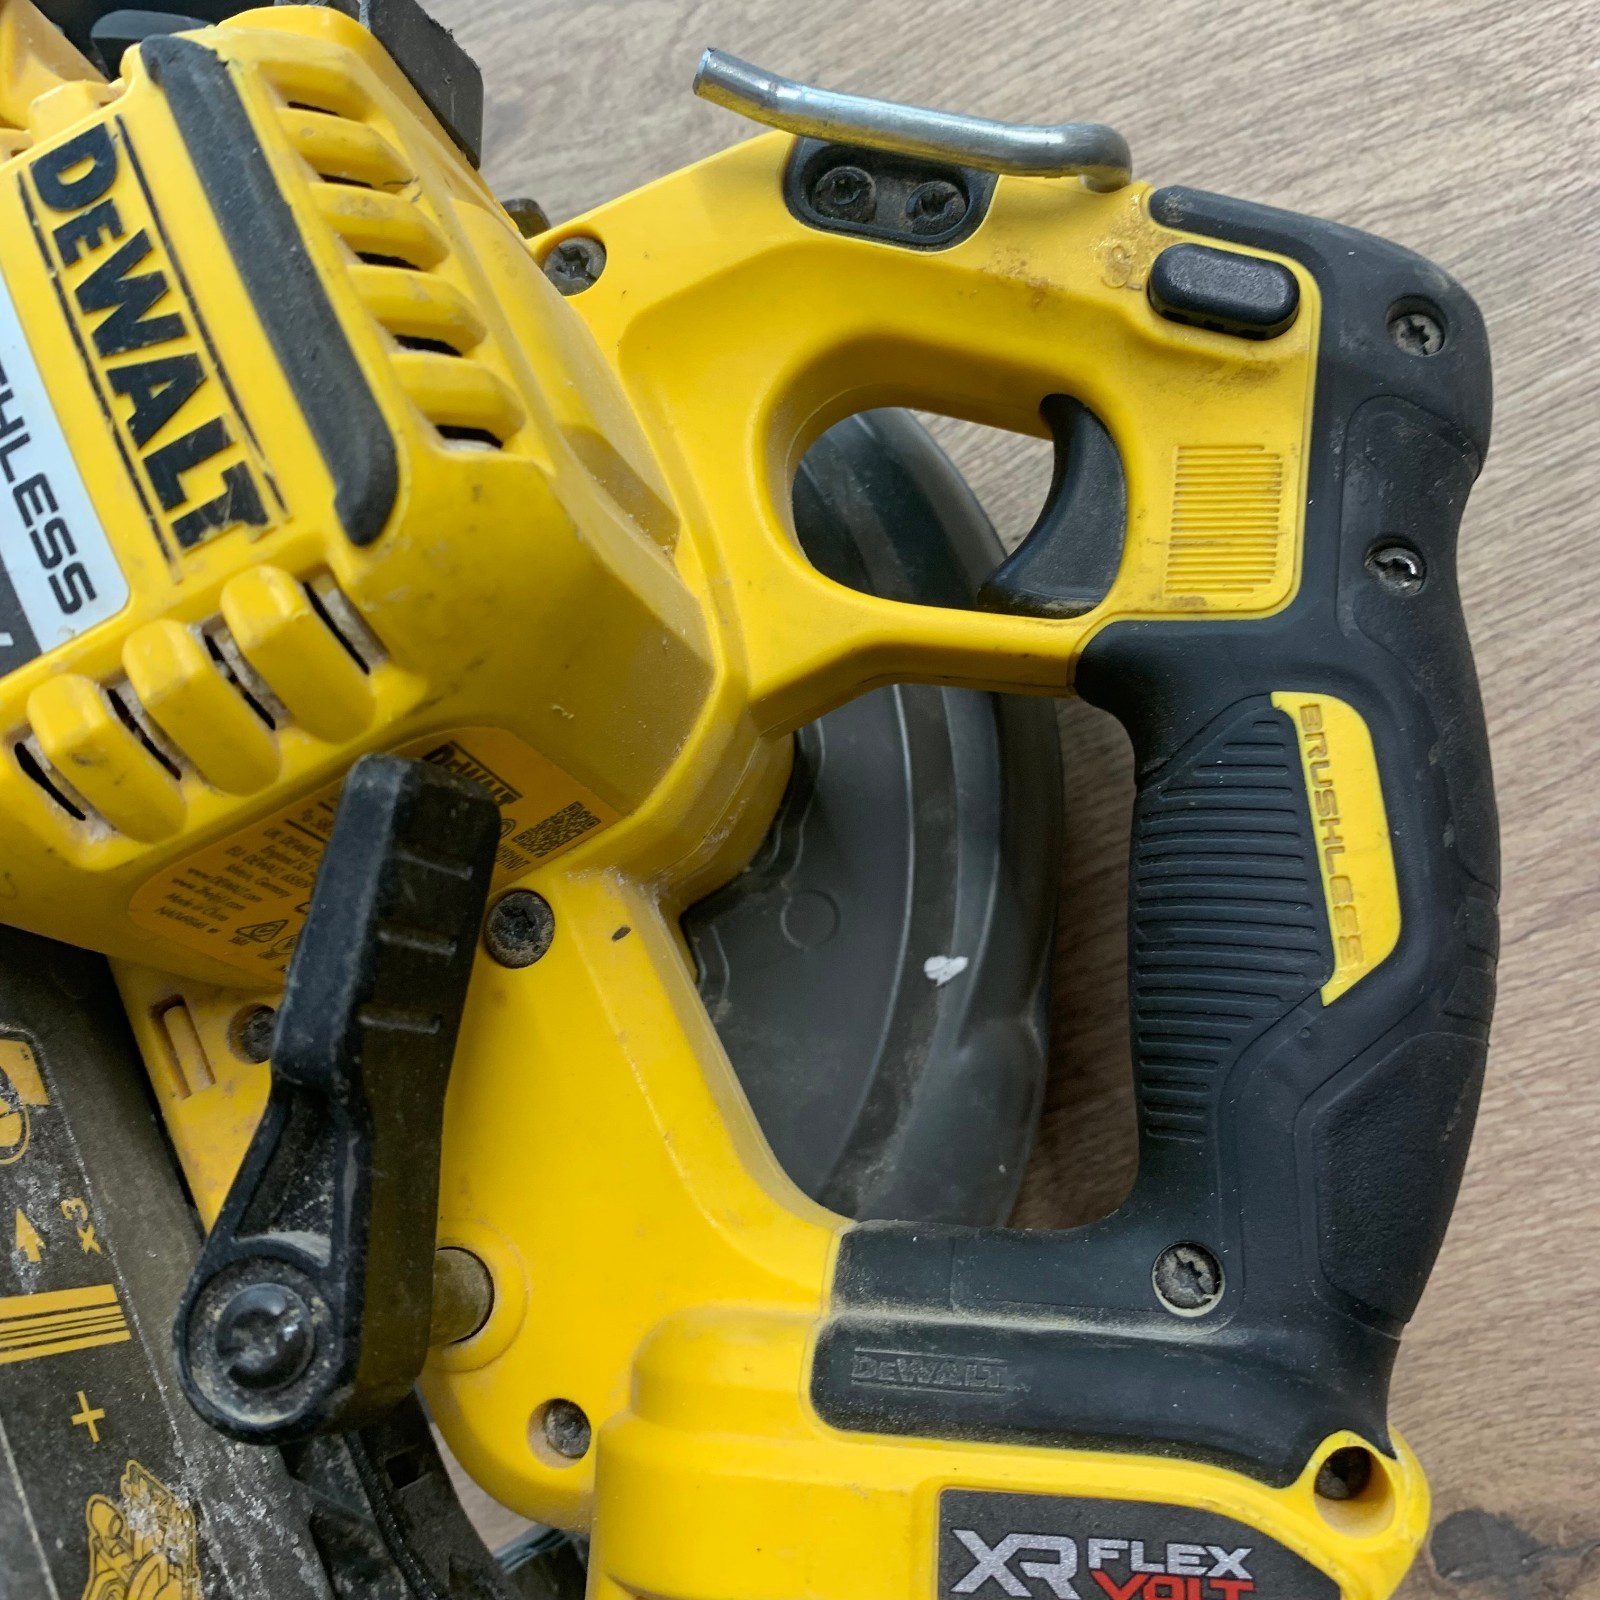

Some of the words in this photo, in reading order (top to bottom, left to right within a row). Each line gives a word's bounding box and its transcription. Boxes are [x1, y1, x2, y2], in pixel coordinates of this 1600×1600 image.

[29, 122, 271, 553] DEWALT
[0, 364, 97, 614] HLESS
[1299, 703, 1365, 965] BRUSHLESS
[850, 1354, 1008, 1388] DEWALT
[950, 1529, 1081, 1600] XR
[1088, 1538, 1253, 1580] FLEX
[1090, 1570, 1255, 1600] VOLT
